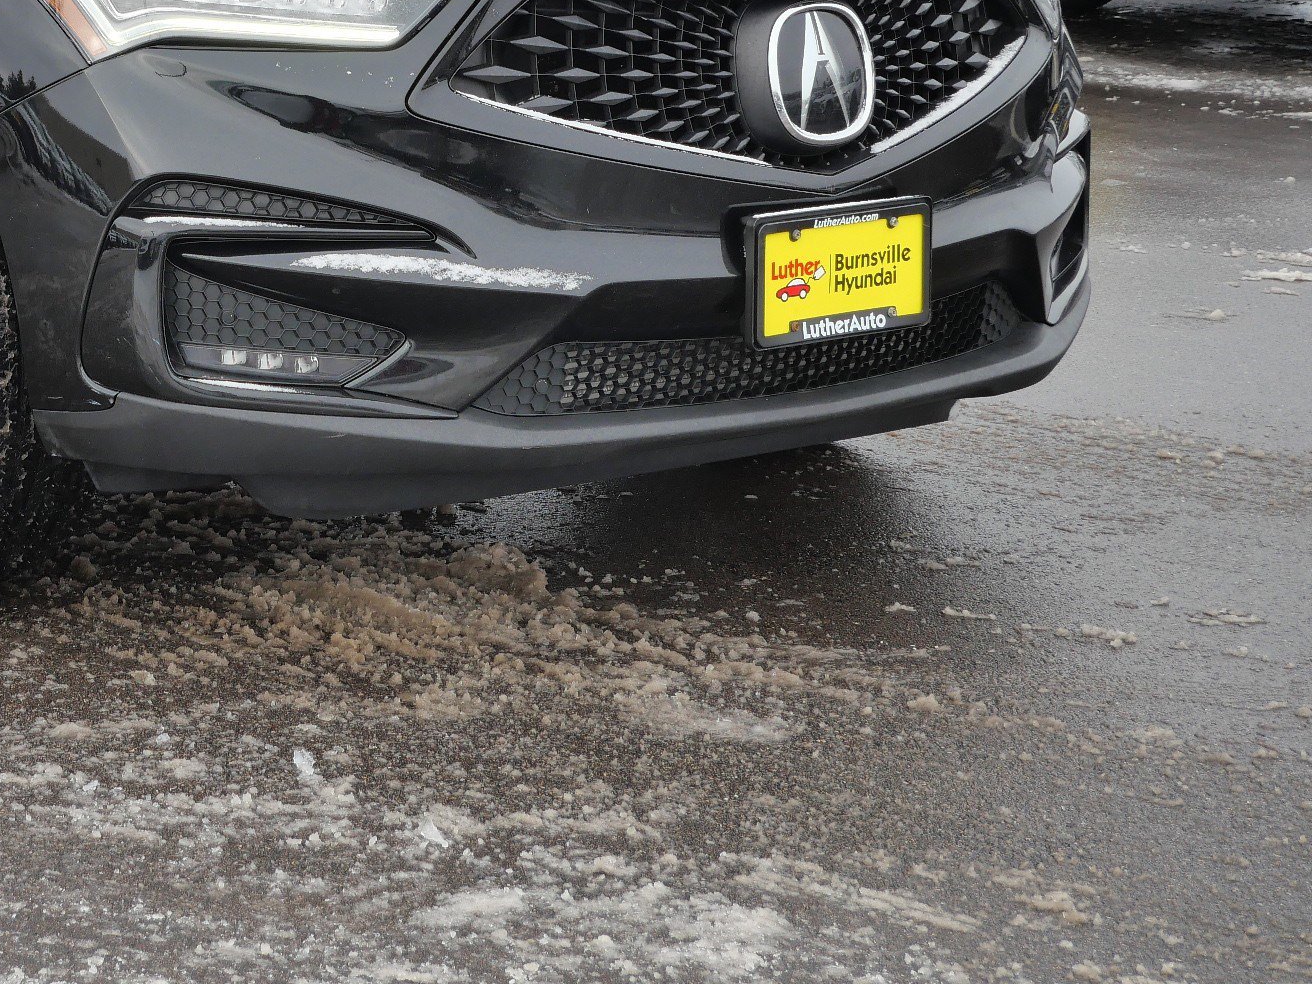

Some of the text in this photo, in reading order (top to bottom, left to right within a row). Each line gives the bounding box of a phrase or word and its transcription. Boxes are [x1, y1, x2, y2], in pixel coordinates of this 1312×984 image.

[813, 213, 879, 228] LutherAuto.com
[771, 258, 821, 281] Luther
[834, 244, 911, 272] Burnsville
[834, 265, 897, 295] Hyundai
[802, 312, 886, 339] LutherAuto
